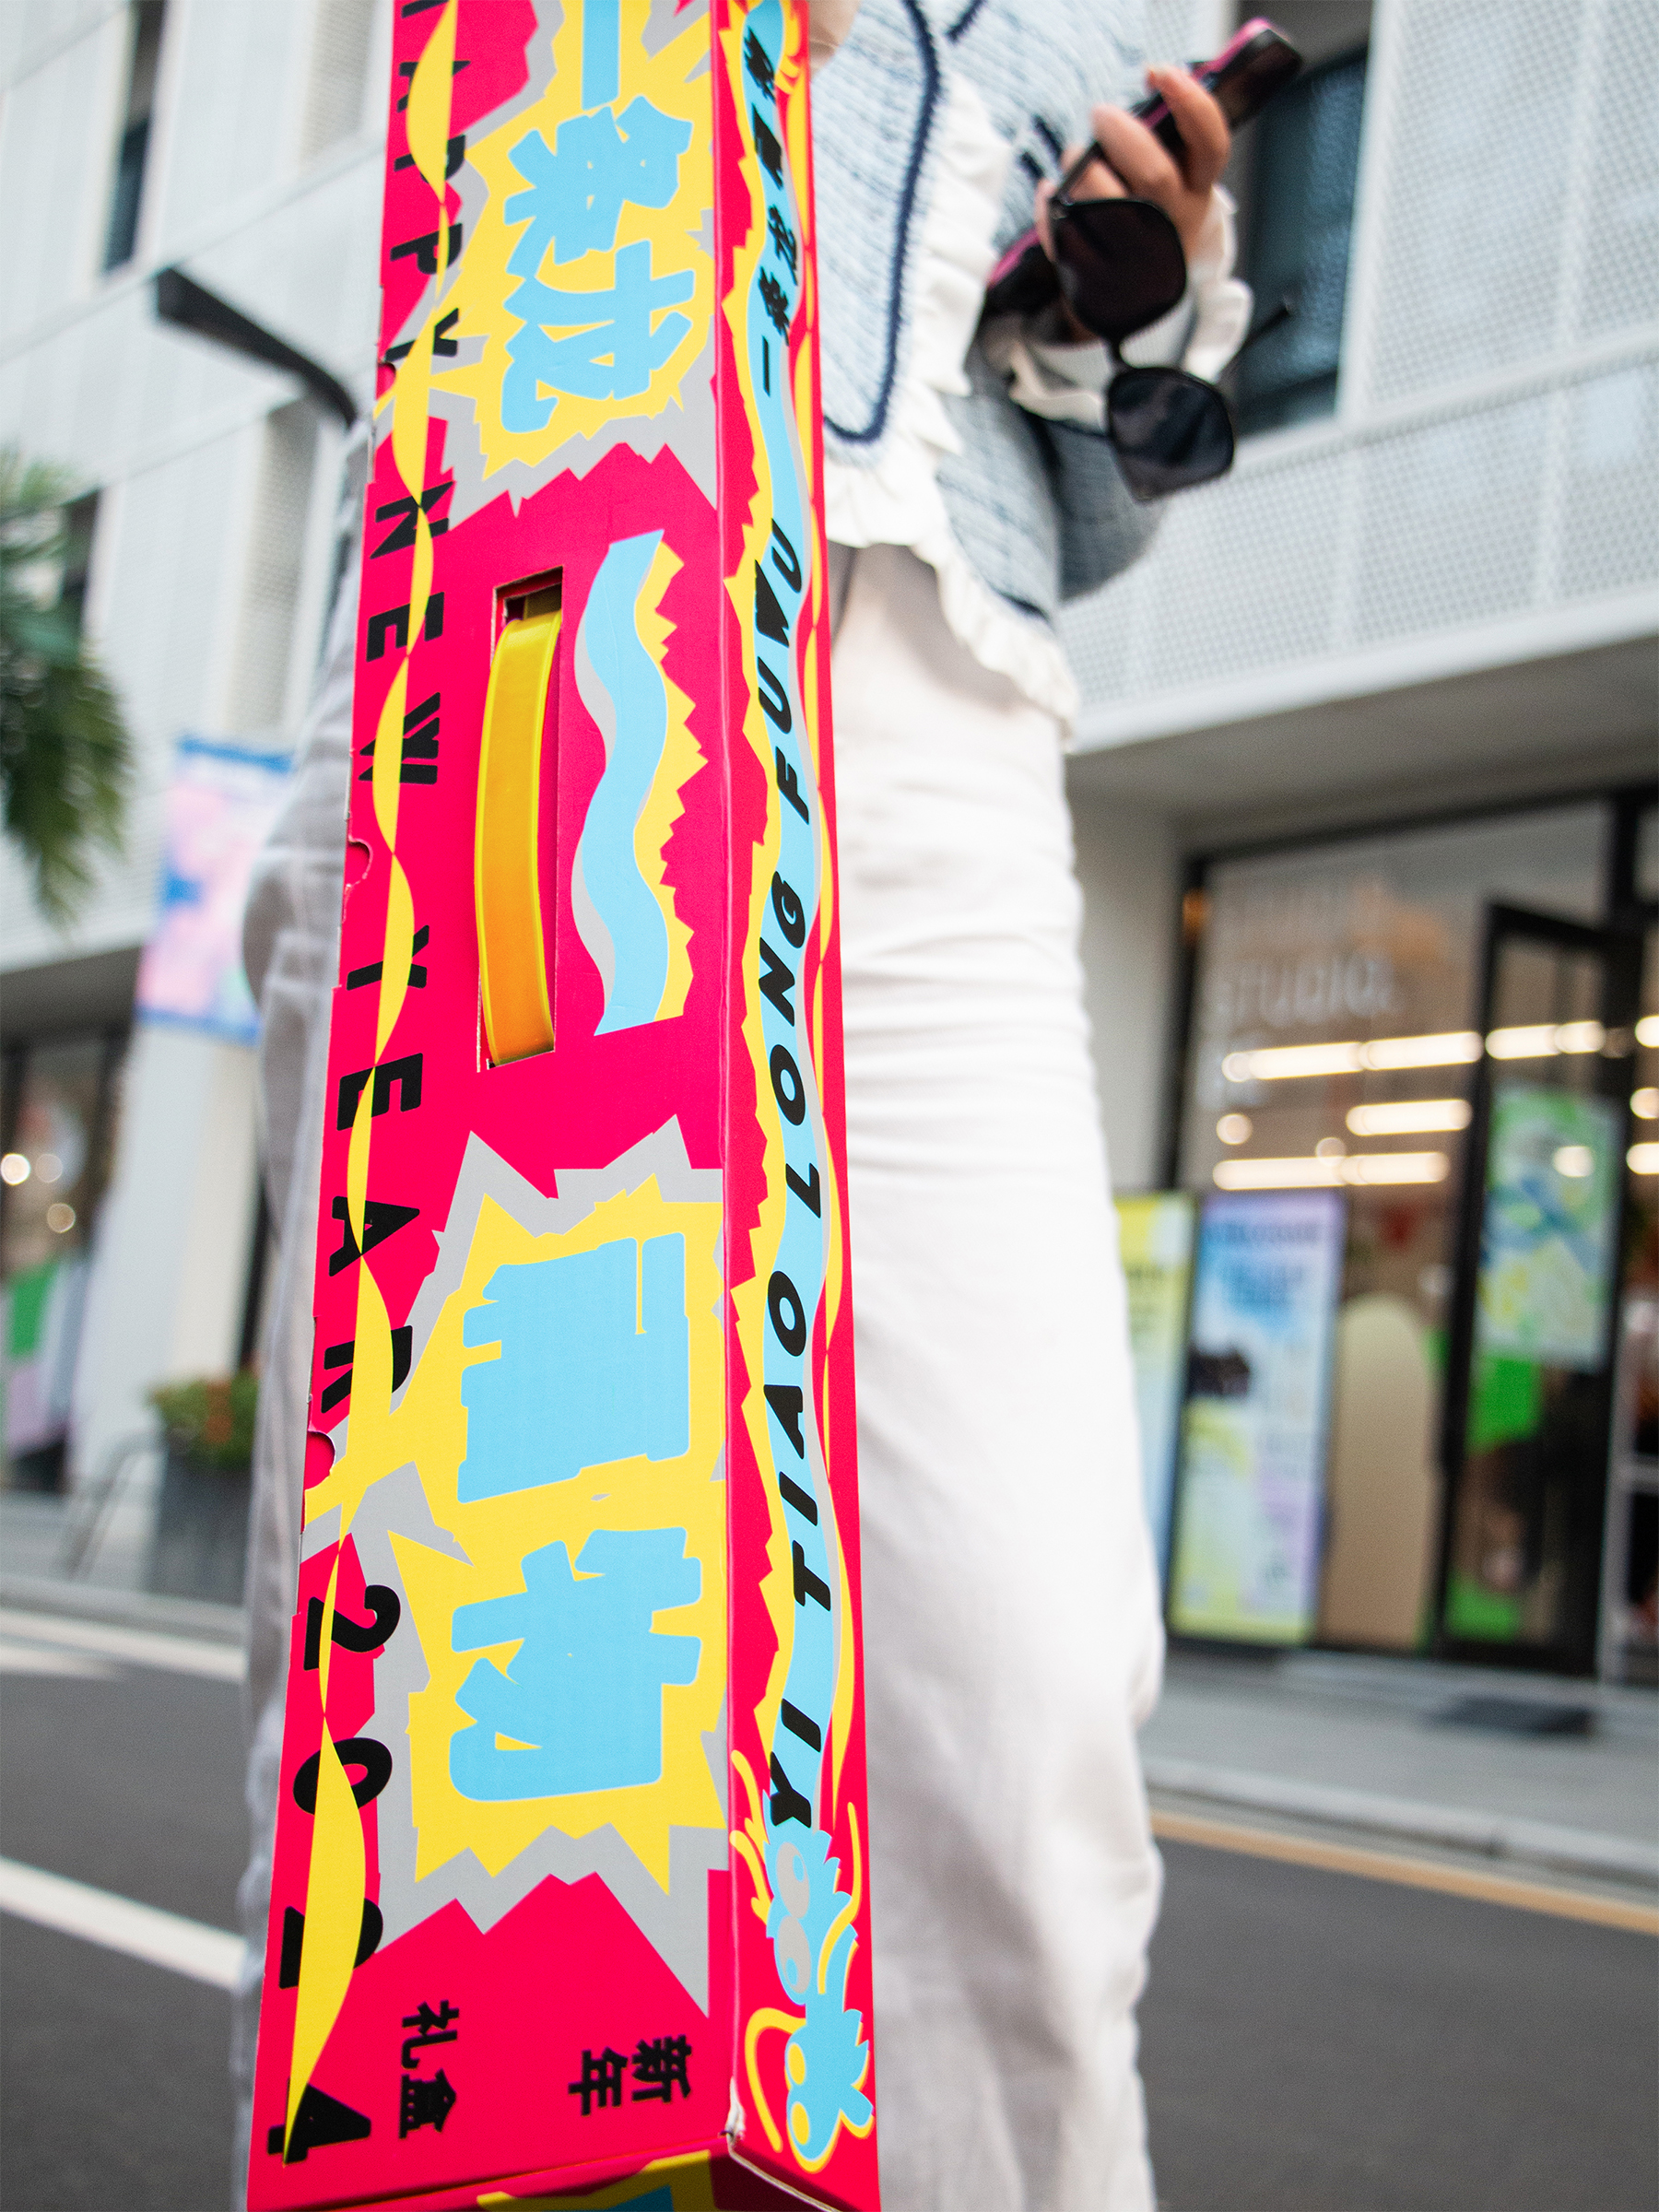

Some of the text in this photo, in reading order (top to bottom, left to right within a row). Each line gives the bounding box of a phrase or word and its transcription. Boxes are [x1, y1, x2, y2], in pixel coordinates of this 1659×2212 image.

[385, 0, 471, 362] APPY
[358, 480, 453, 785] NEW
[321, 924, 429, 1414] YEAR
[758, 870, 821, 1218] LONG
[763, 1270, 831, 1612] TIAO
[770, 1698, 821, 1829] YI
[398, 1999, 461, 2140] 礼盒
[568, 2034, 693, 2117] 新年
